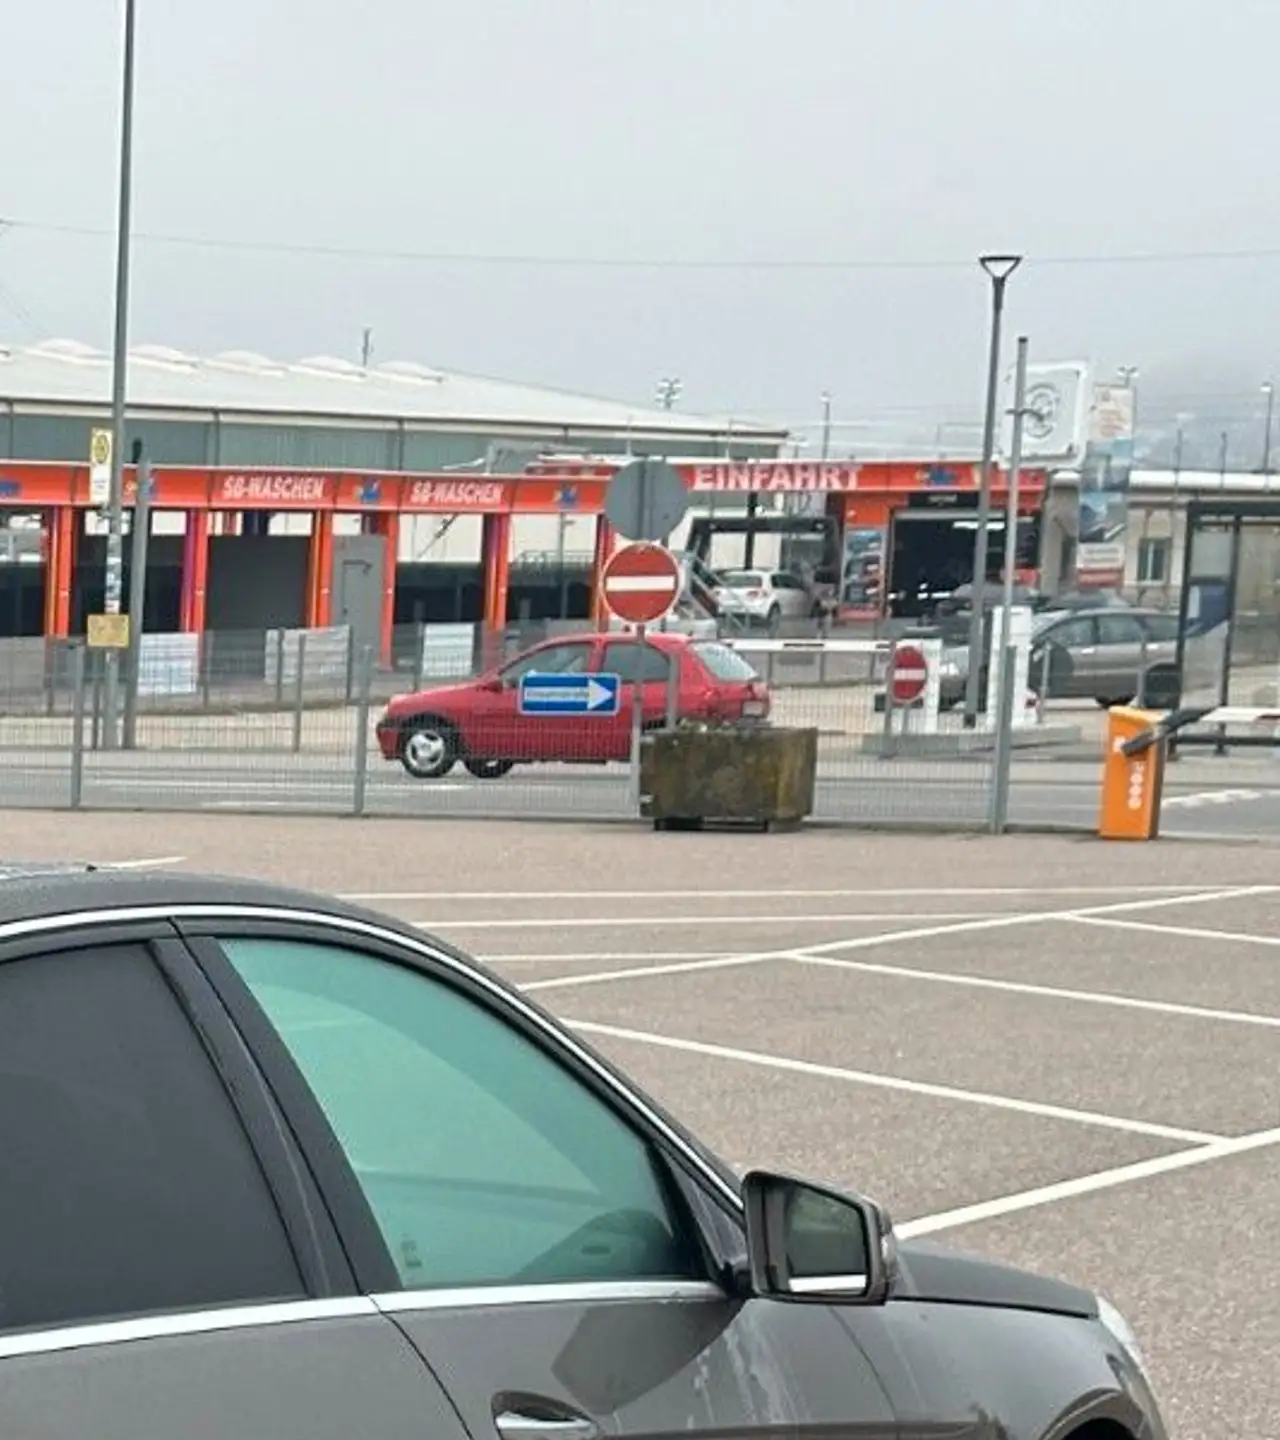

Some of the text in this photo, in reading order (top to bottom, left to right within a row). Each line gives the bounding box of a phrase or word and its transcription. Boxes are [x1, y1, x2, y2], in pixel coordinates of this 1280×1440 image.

[223, 475, 325, 500] SB-WASCHEN
[693, 463, 861, 491] EINFAHRT
[409, 481, 504, 504] SB-WASCHEN
